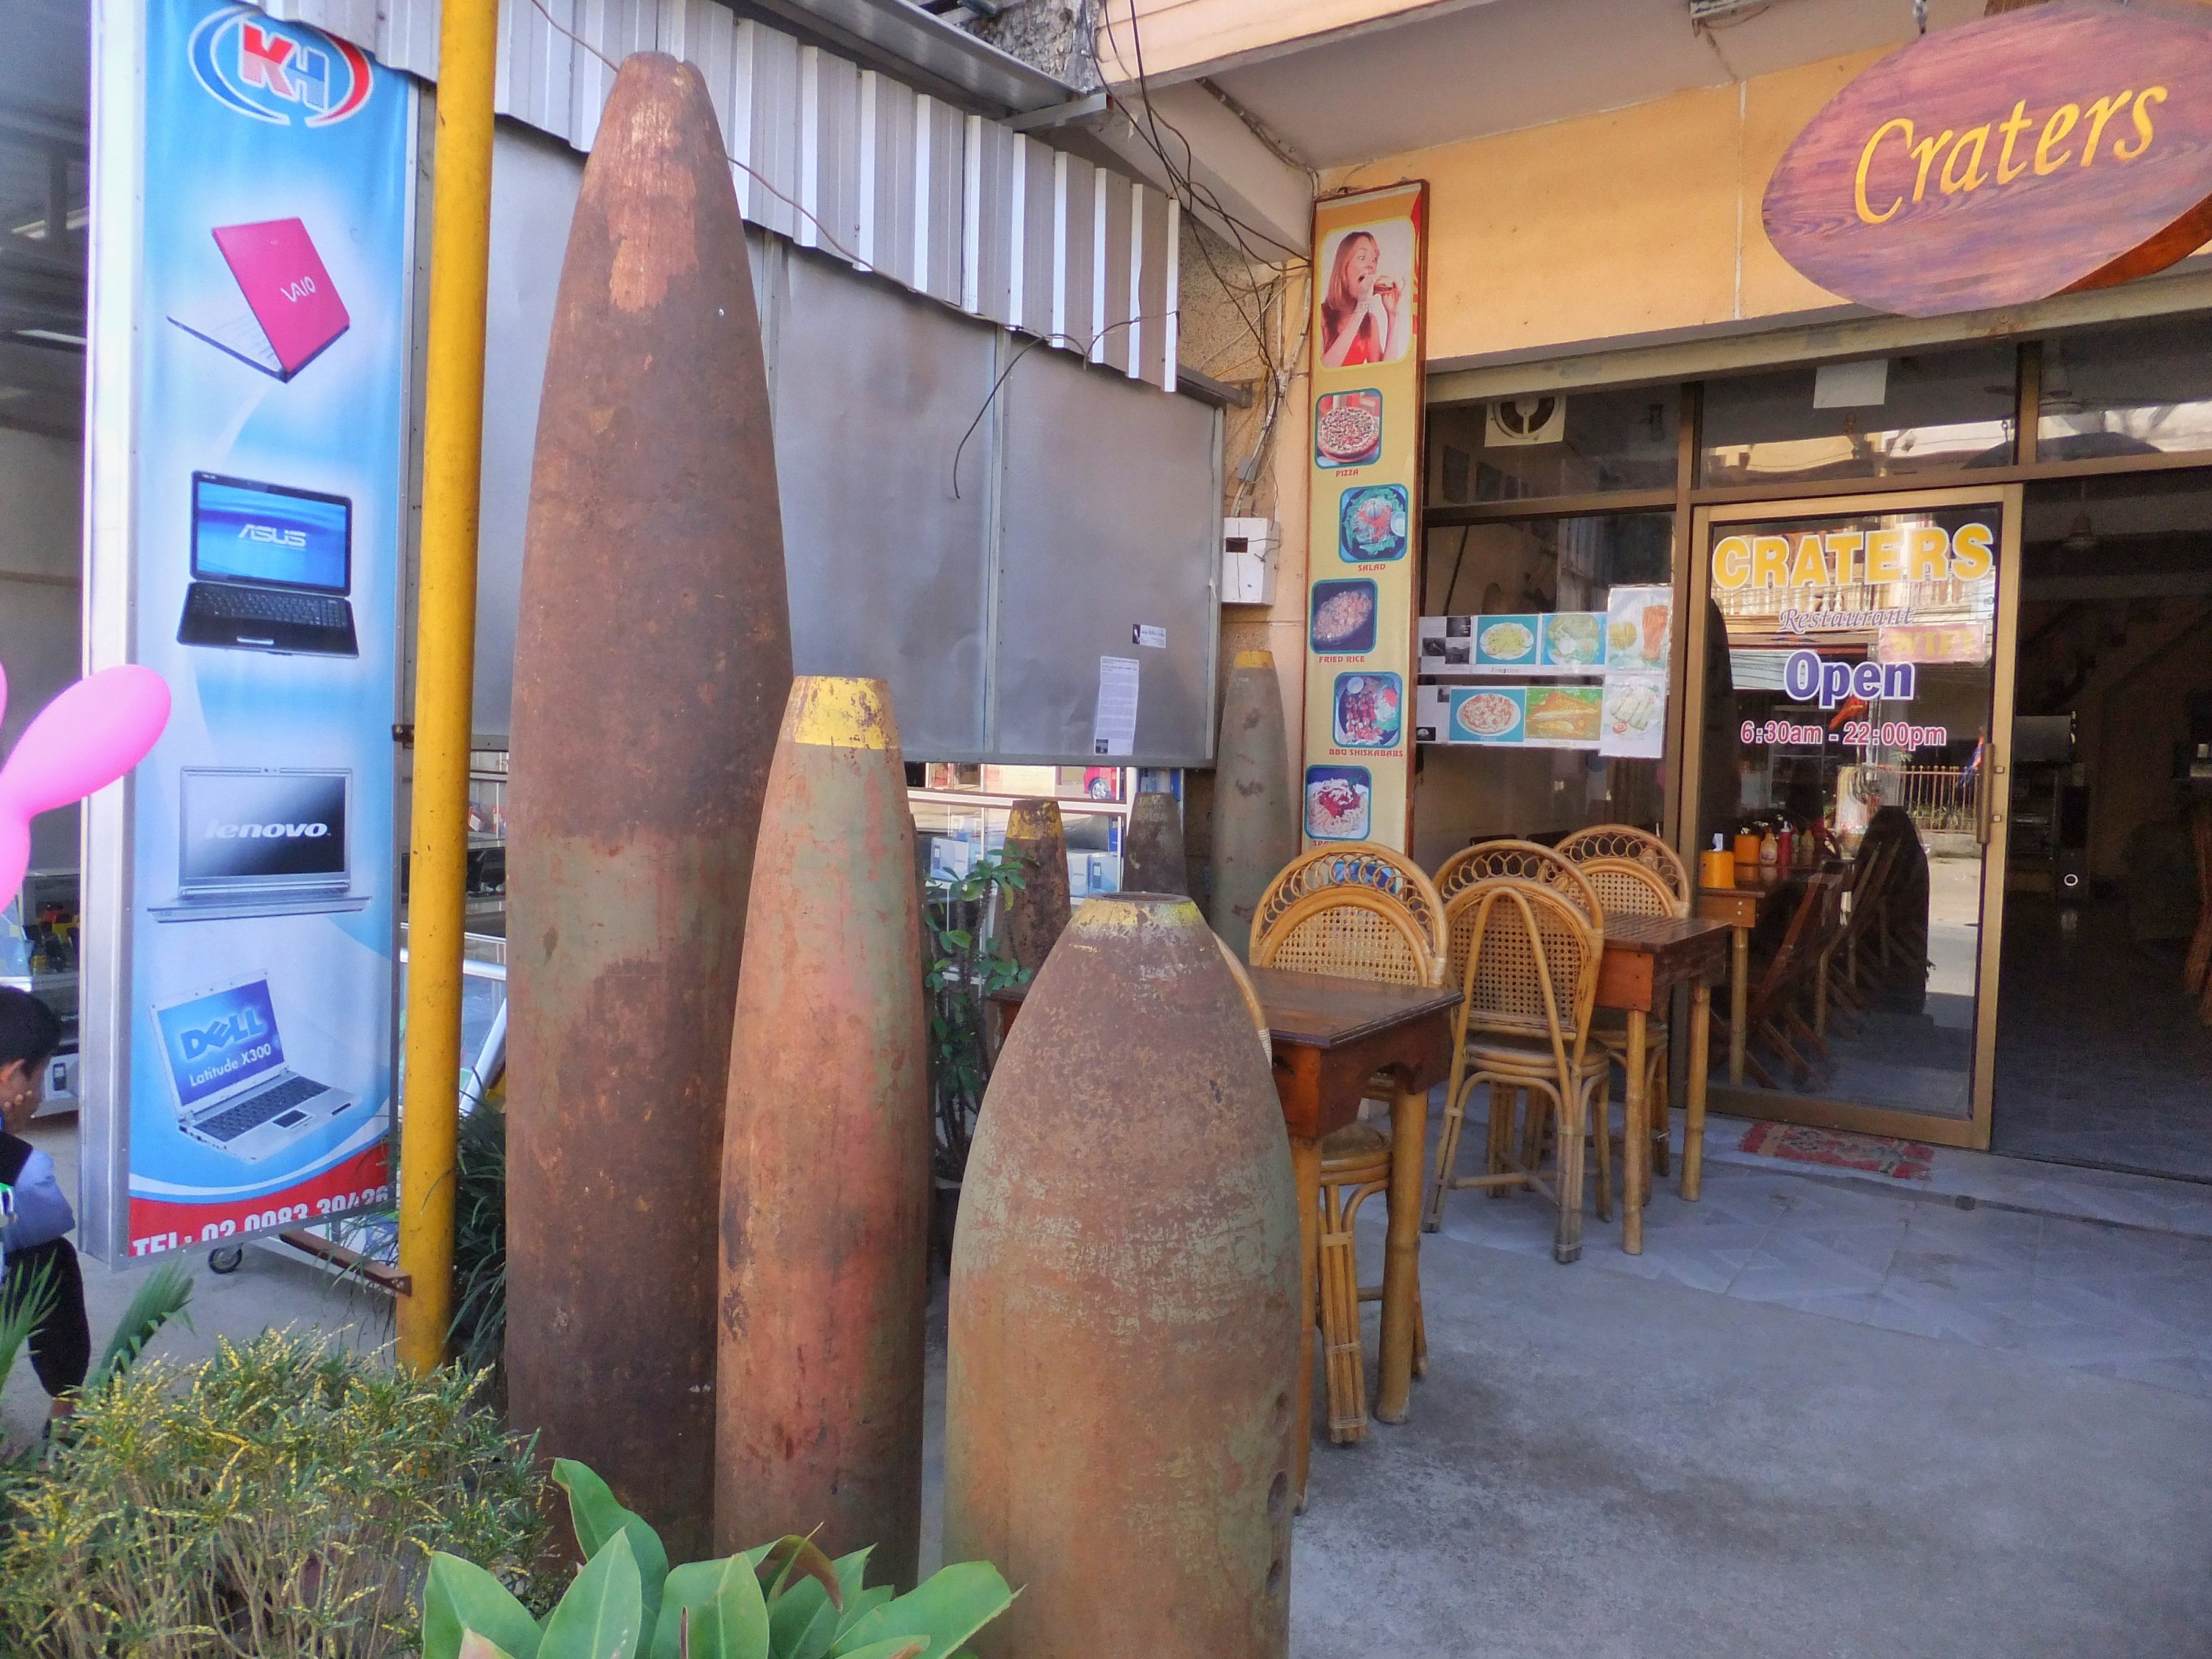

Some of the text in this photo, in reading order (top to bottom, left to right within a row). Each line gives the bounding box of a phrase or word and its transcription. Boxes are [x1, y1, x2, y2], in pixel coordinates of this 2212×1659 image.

[1855, 85, 2168, 225] Craters
[280, 276, 316, 303] VAIO
[1335, 469, 1359, 478] PIZZA
[238, 523, 306, 547] ASUS
[1358, 563, 1386, 572] SALAD
[1712, 523, 1994, 590] CRATERS
[1777, 606, 1915, 633] Restaurant
[1784, 649, 1915, 709] Open
[1741, 720, 1823, 744] 6:30am
[1843, 721, 1947, 751] 22:00pm
[207, 818, 328, 838] lenovo
[180, 1009, 265, 1059] DELL
[189, 1042, 272, 1087] Latitude X300
